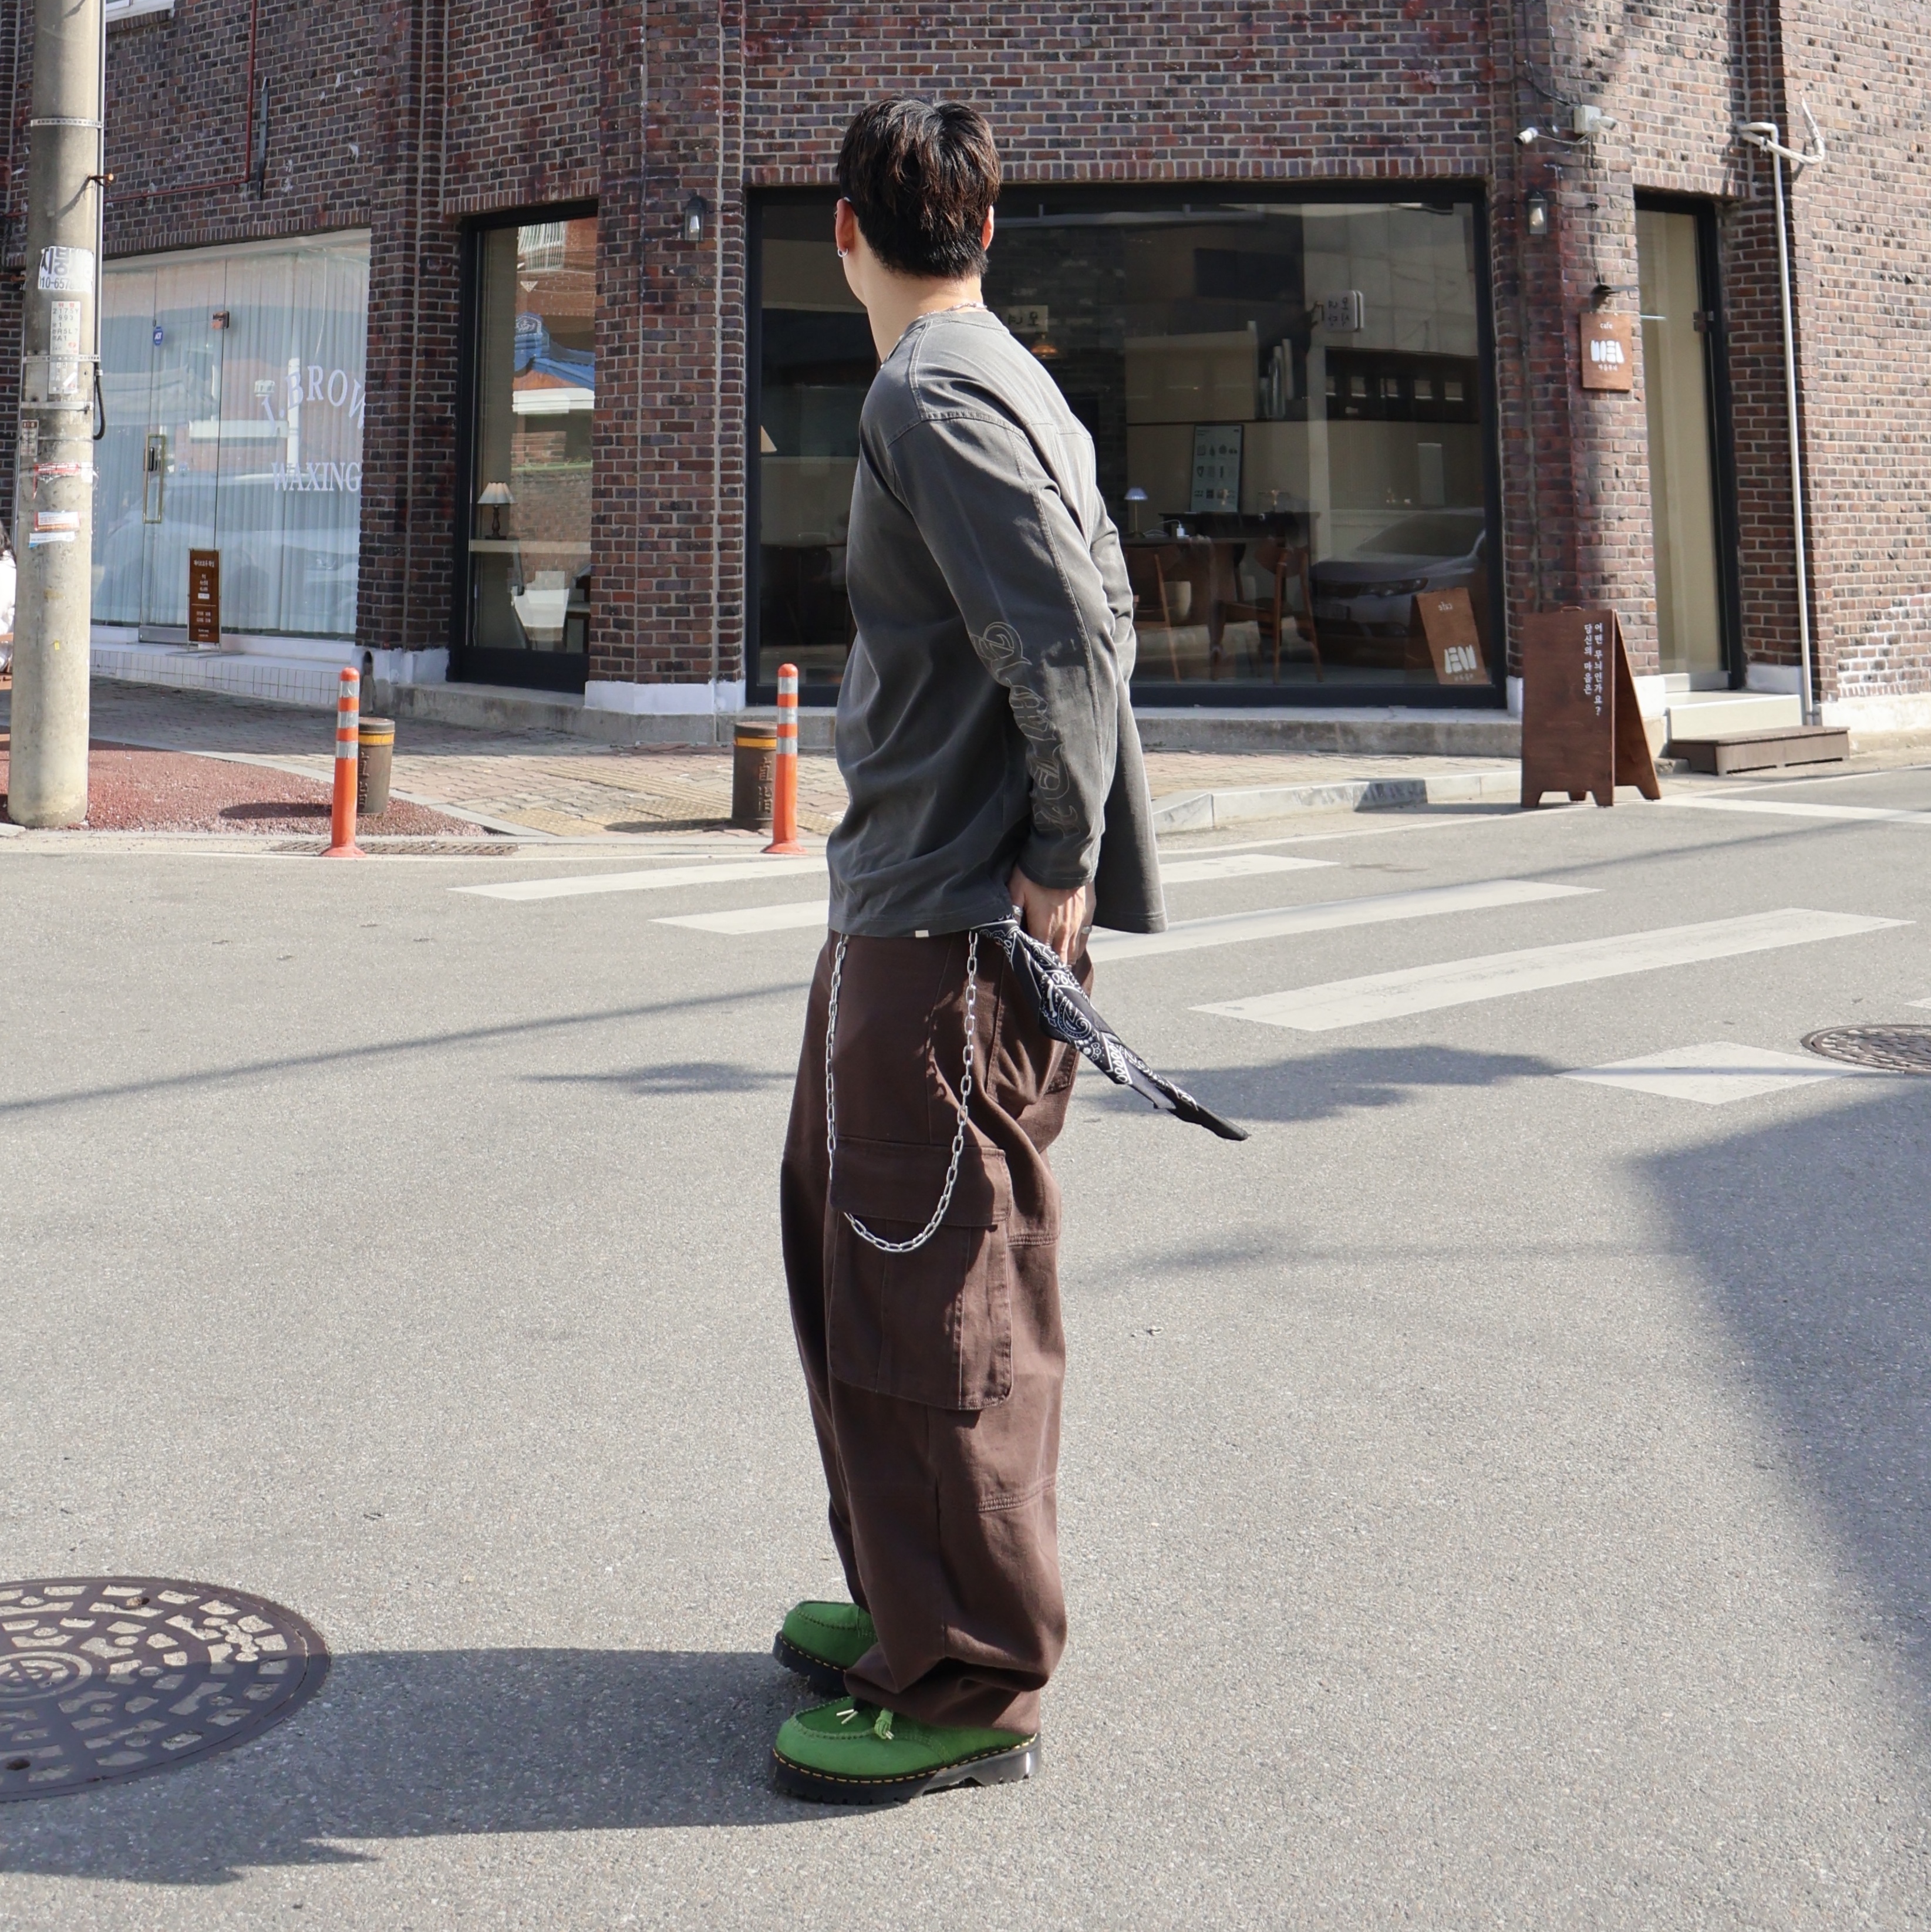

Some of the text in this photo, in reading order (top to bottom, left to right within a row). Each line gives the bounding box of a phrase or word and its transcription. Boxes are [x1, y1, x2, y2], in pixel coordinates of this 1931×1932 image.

[271, 461, 363, 491] WAXING
[1583, 623, 1592, 695] 당신의 마음은
[1593, 622, 1603, 716] 어떤 무늬인가요?
